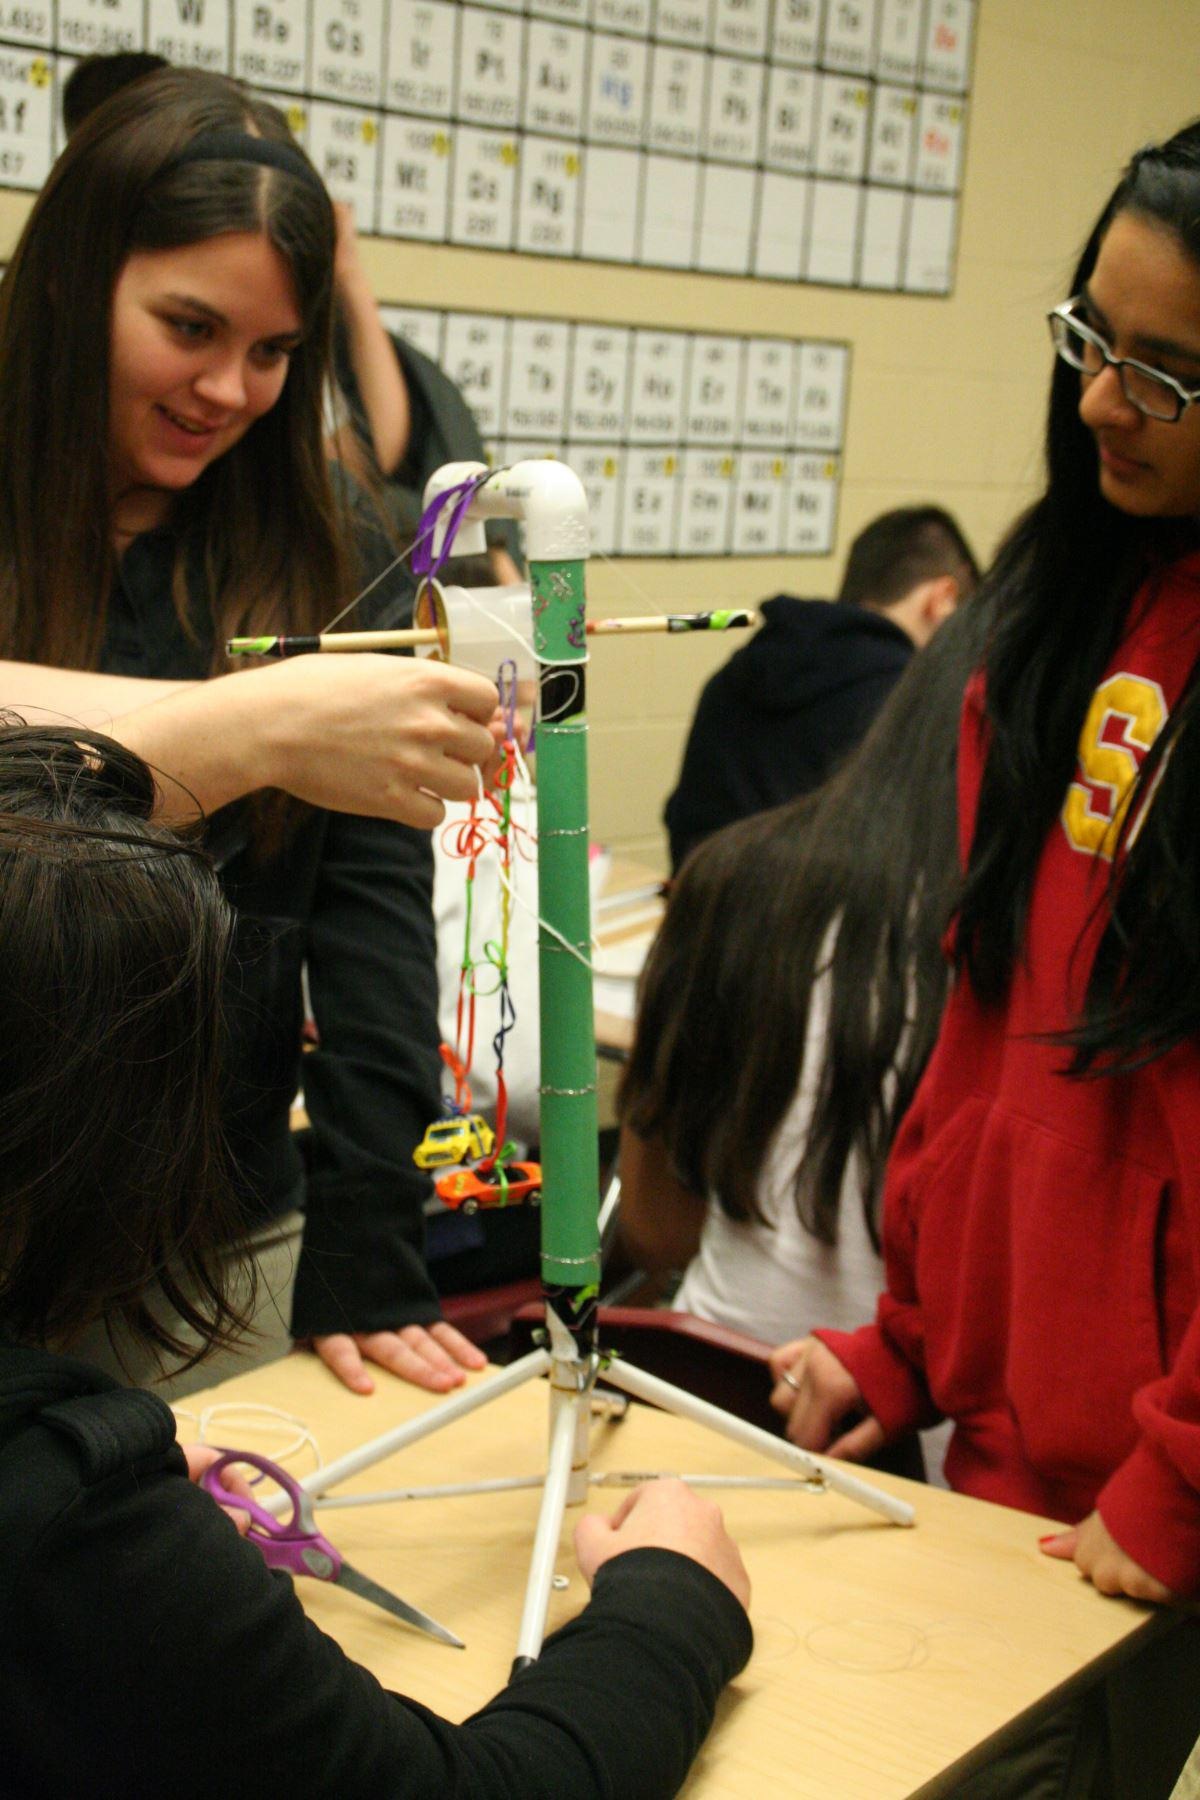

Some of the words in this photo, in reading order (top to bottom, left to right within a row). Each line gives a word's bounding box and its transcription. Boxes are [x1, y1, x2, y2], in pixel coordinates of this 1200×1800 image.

[253, 5, 289, 43] Re
[325, 20, 364, 57] Os
[476, 49, 505, 82] Pt
[537, 63, 569, 93] Au
[600, 76, 633, 110] Hg
[586, 366, 616, 402] Dy
[1061, 672, 1169, 863] S
